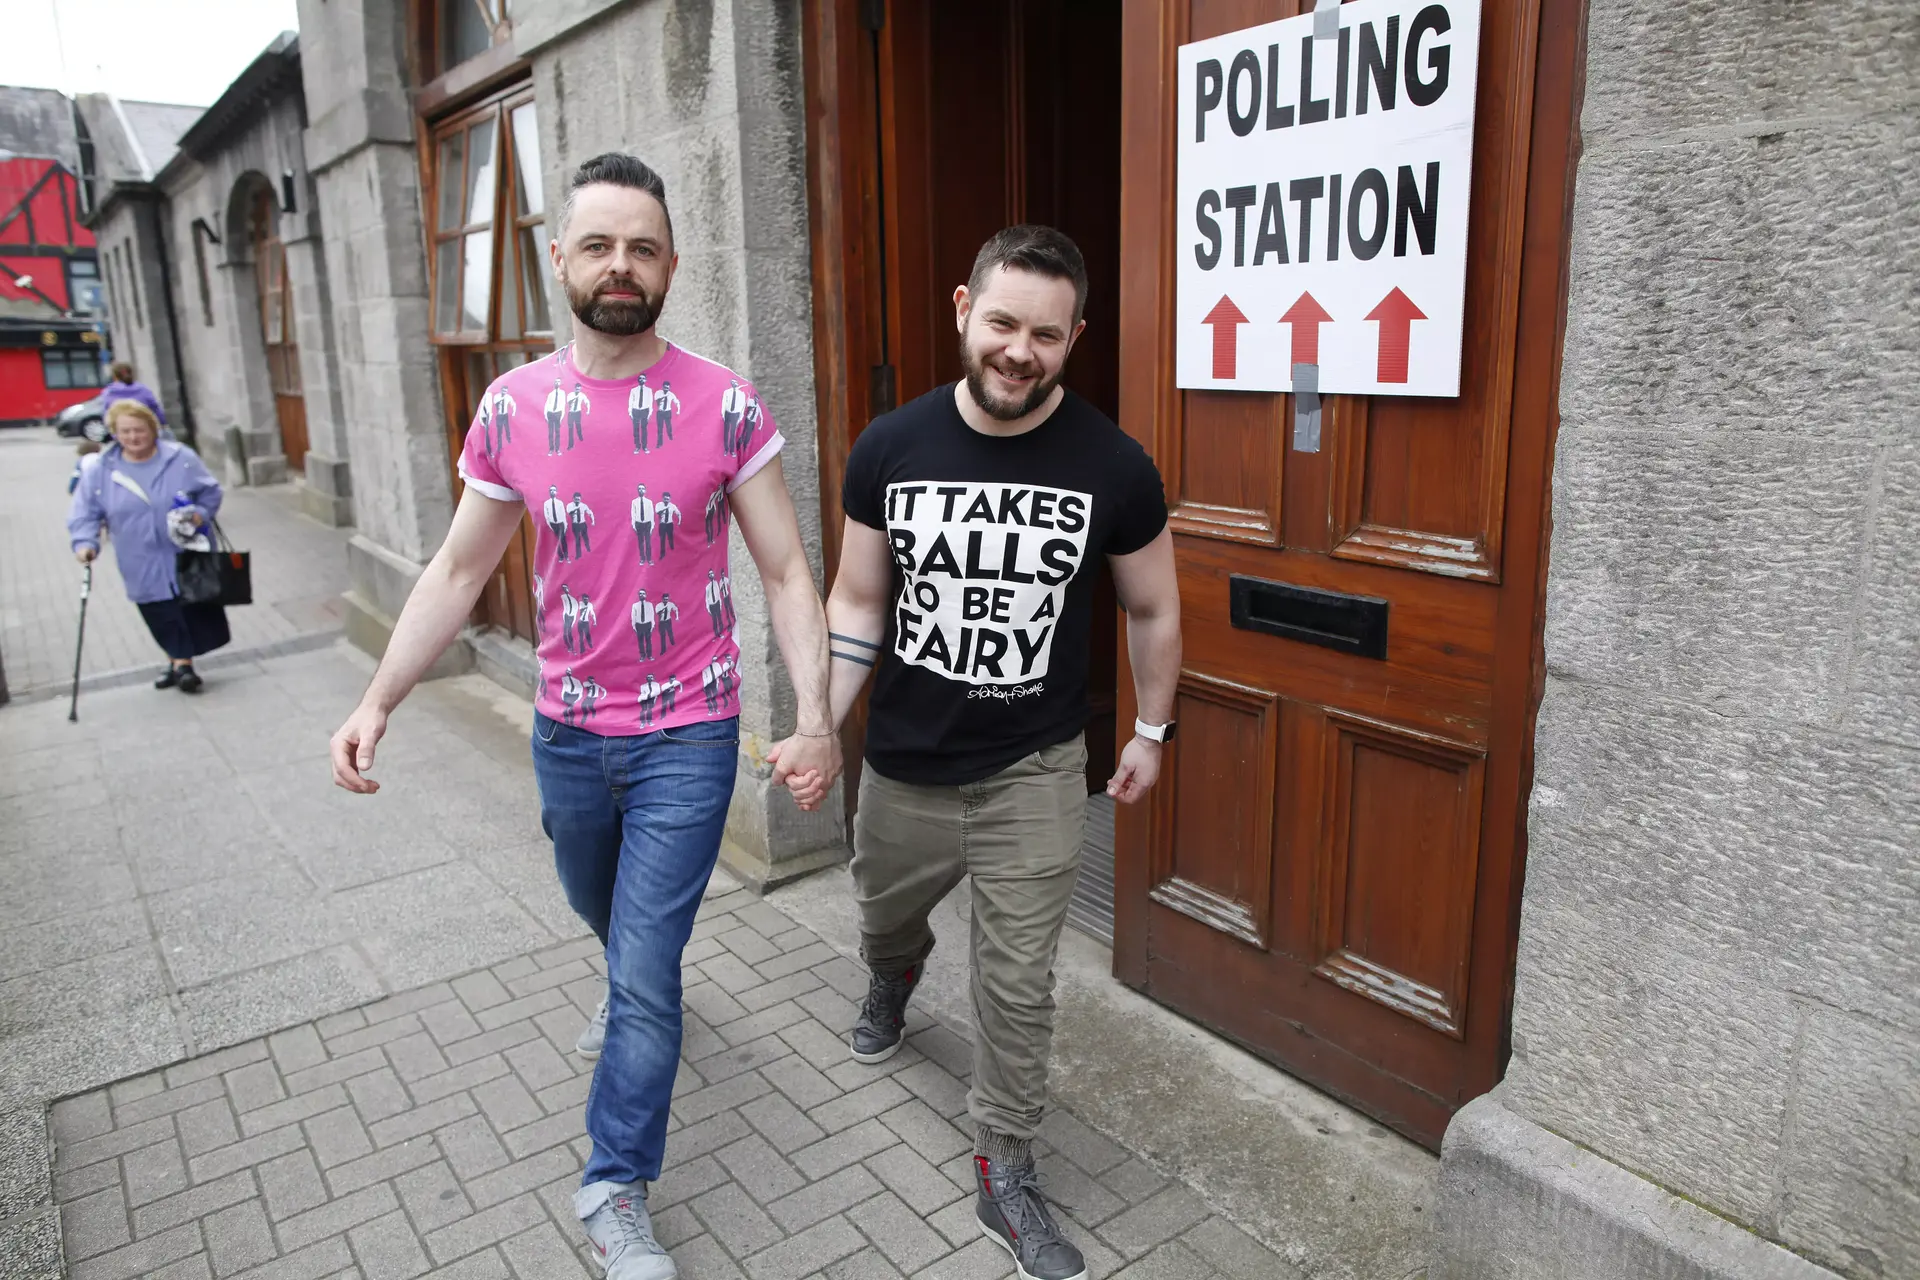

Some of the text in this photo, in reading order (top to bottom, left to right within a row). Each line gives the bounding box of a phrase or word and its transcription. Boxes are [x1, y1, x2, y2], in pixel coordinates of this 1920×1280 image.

[1195, 4, 1451, 143] POLLING
[1194, 161, 1440, 271] STATION
[888, 486, 1085, 534] IT TAKES
[890, 528, 1078, 586] BALLS
[963, 588, 1014, 623] BE
[1030, 592, 1055, 622] A
[898, 607, 1052, 678] FAIRY
